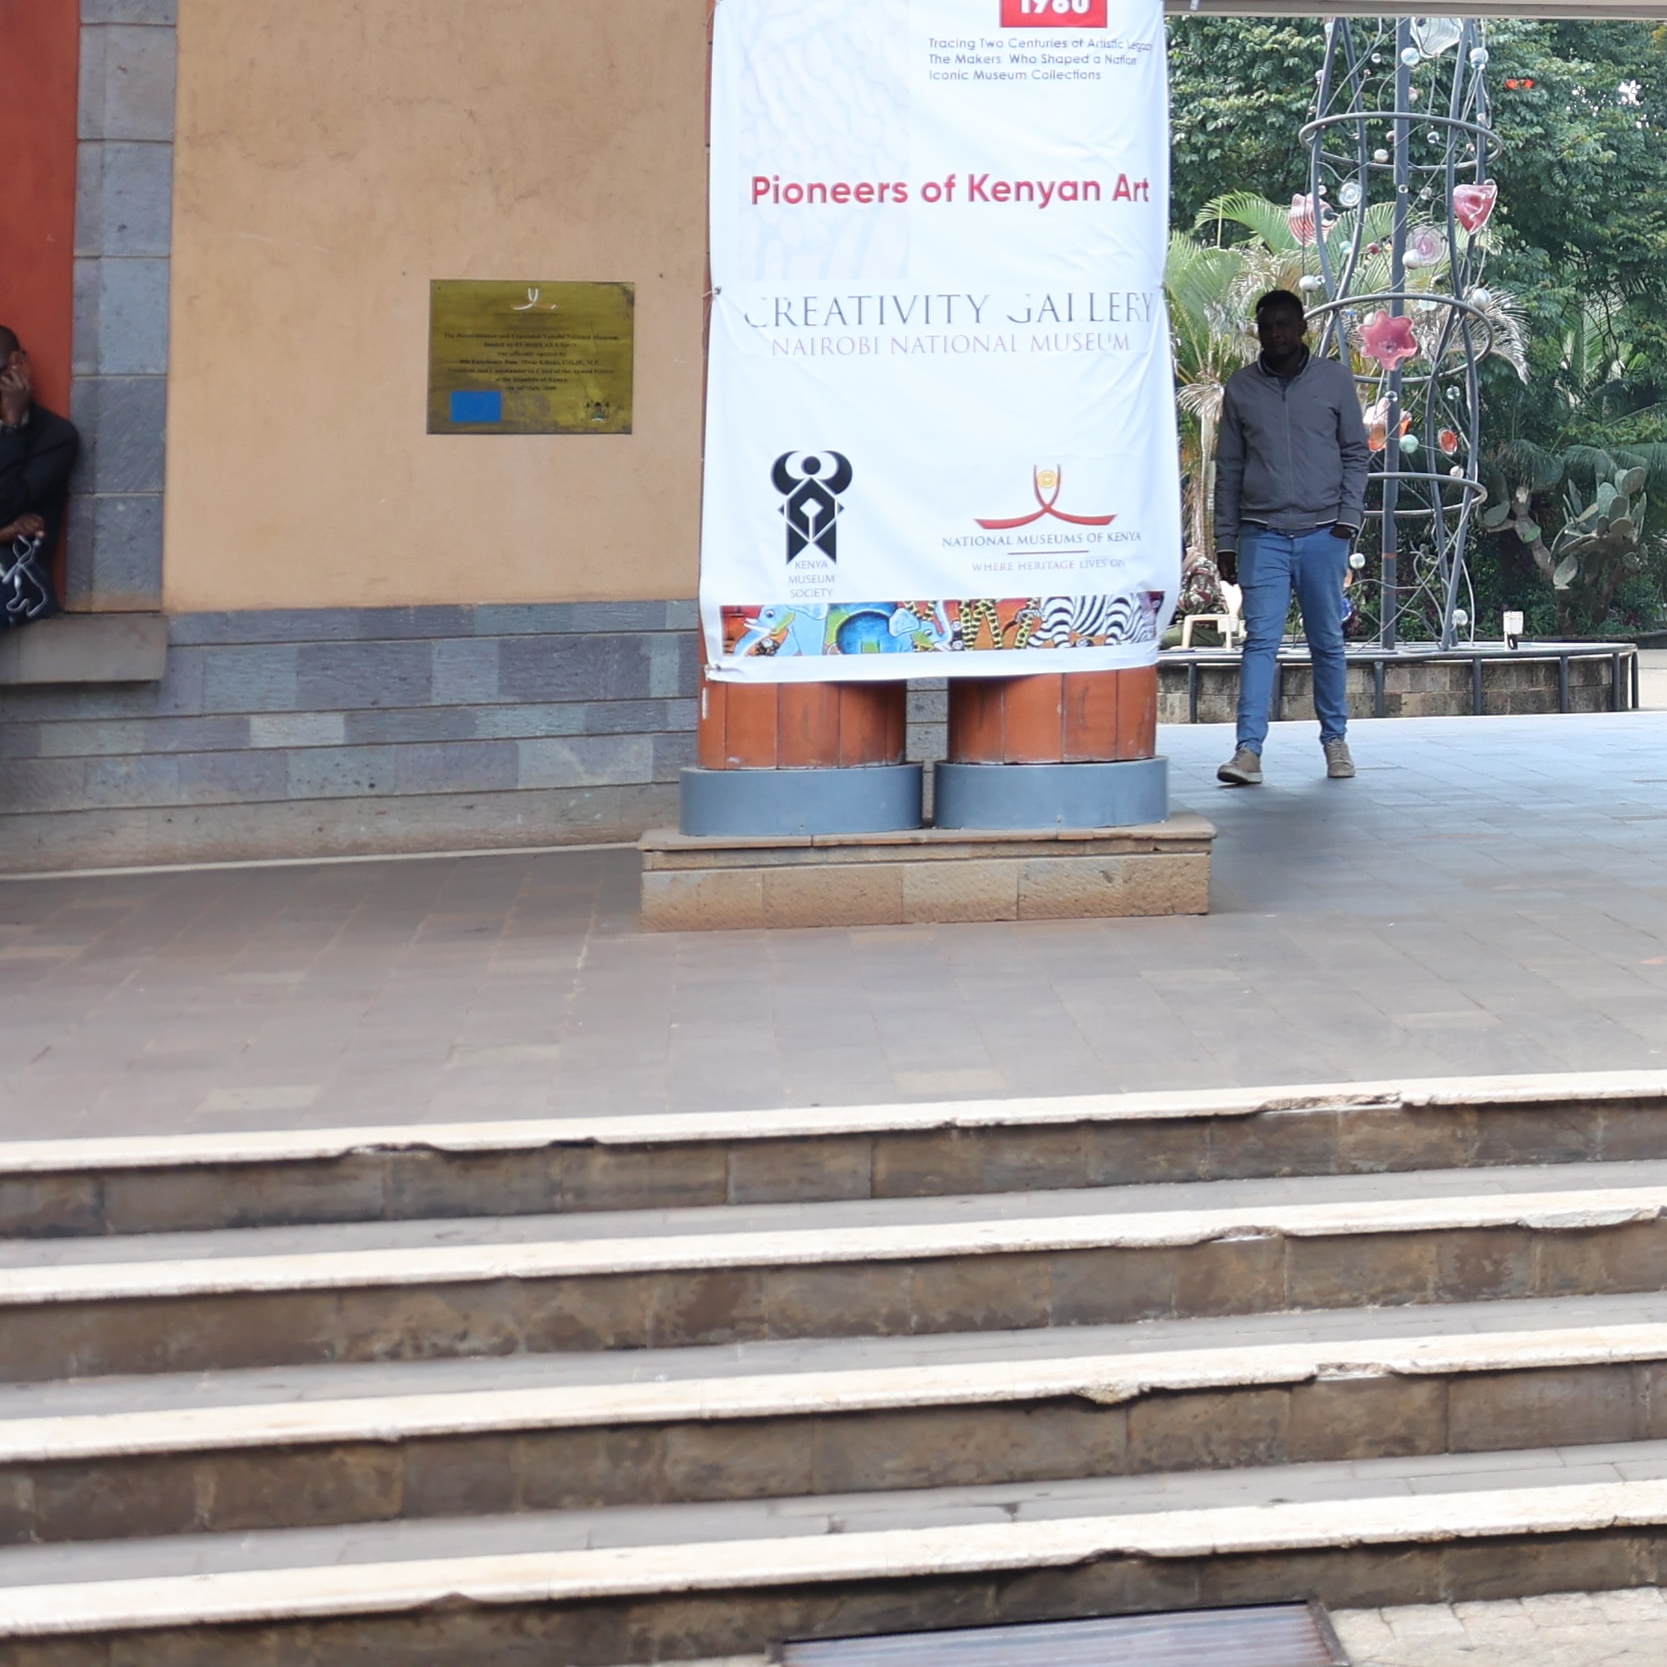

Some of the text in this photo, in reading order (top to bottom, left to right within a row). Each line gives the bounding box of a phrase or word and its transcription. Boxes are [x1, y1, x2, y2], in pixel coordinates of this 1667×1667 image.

[928, 38, 976, 51] Tracing
[979, 38, 1004, 49] Two
[1008, 38, 1068, 49] Centuries
[1070, 38, 1083, 49] of
[1087, 38, 1125, 49] Artistic
[928, 53, 1137, 68] The Makers Who Shaped a Nation
[928, 69, 1101, 81] Iconic Museum Collections
[751, 173, 1150, 210] Pioneers of Kenyan Art
[771, 332, 1131, 357] NAIROBI NATIONAL MUSEUM
[941, 531, 1142, 548] NATIONAL MUSEUMS OF KENYA
[794, 560, 828, 570] KENYA
[971, 558, 1126, 572] WHERE HERITAGE LIVES ON
[788, 574, 835, 585] MUSEUM
[789, 588, 834, 599] SOCIETY
